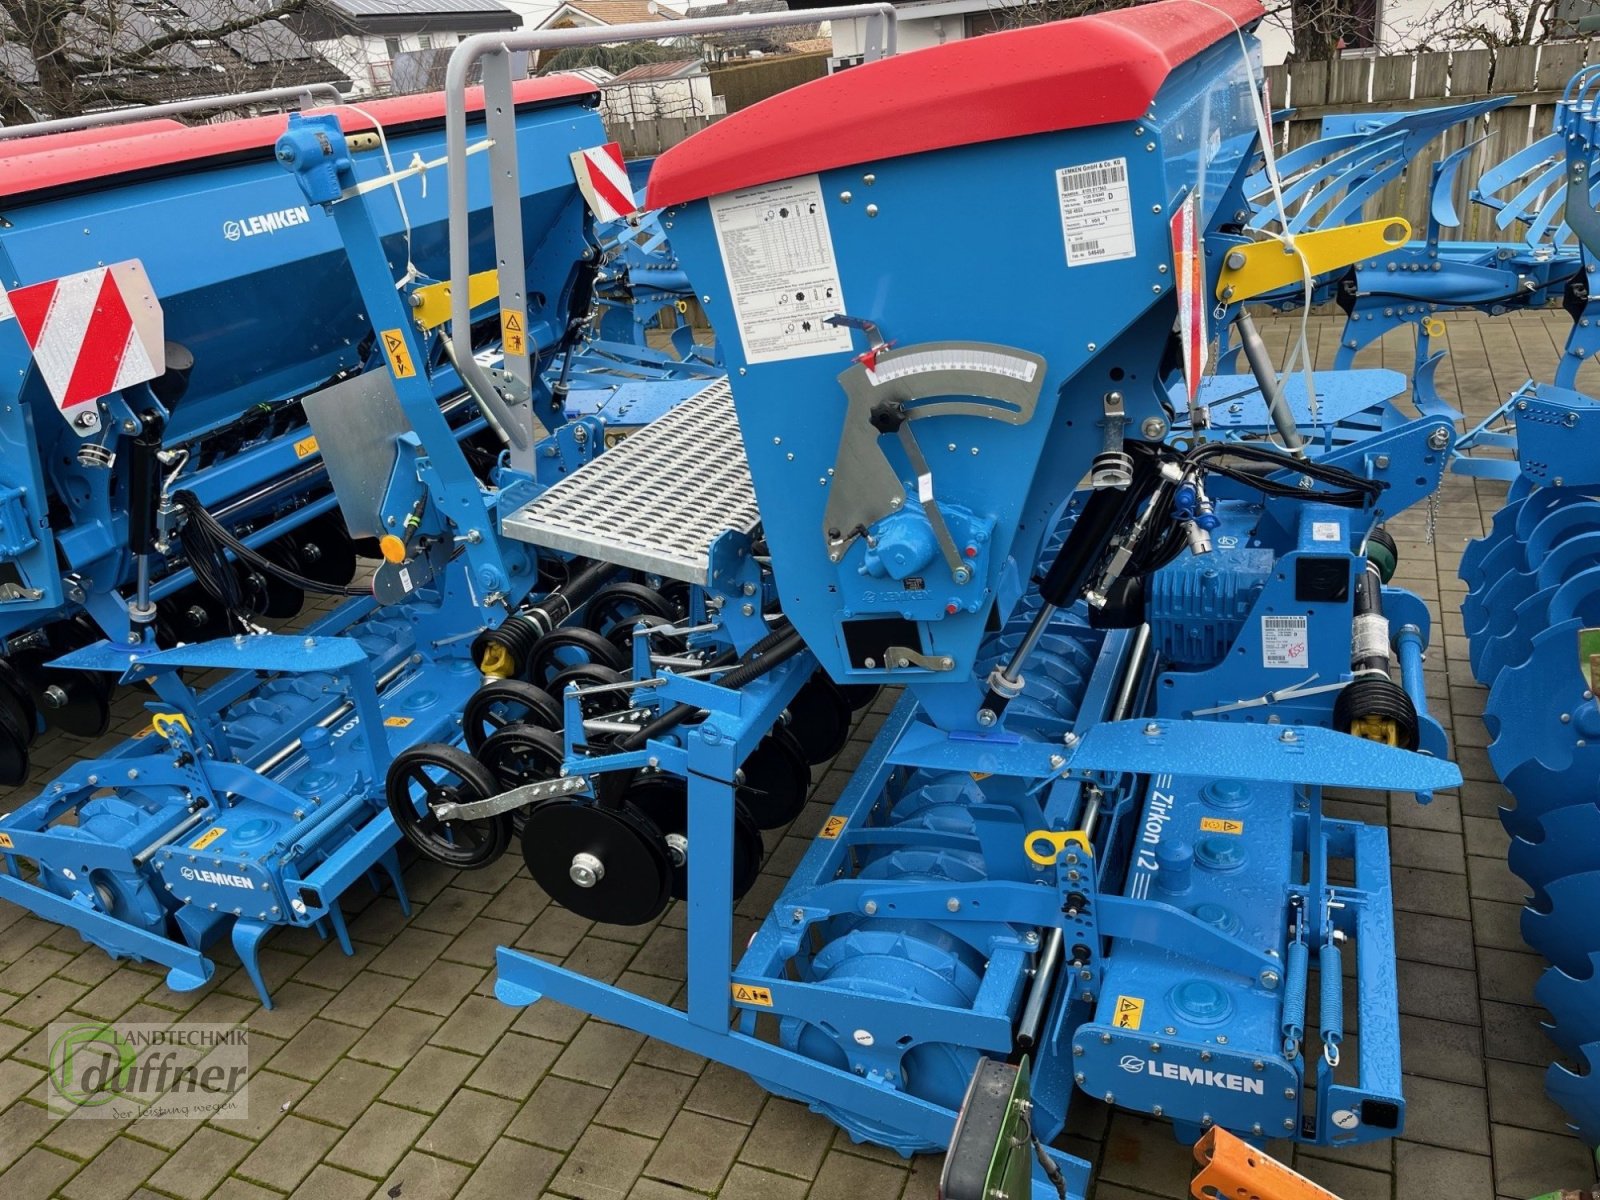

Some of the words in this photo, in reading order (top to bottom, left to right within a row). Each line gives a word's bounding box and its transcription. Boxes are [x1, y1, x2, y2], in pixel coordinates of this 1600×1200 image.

[1062, 167, 1082, 175] LEMKEN
[240, 206, 310, 236] LEMKEN
[1143, 791, 1174, 844] Zirkon
[1137, 850, 1159, 870] 12
[193, 869, 254, 889] LEMKEN
[1148, 1060, 1264, 1095] LEMKEN
